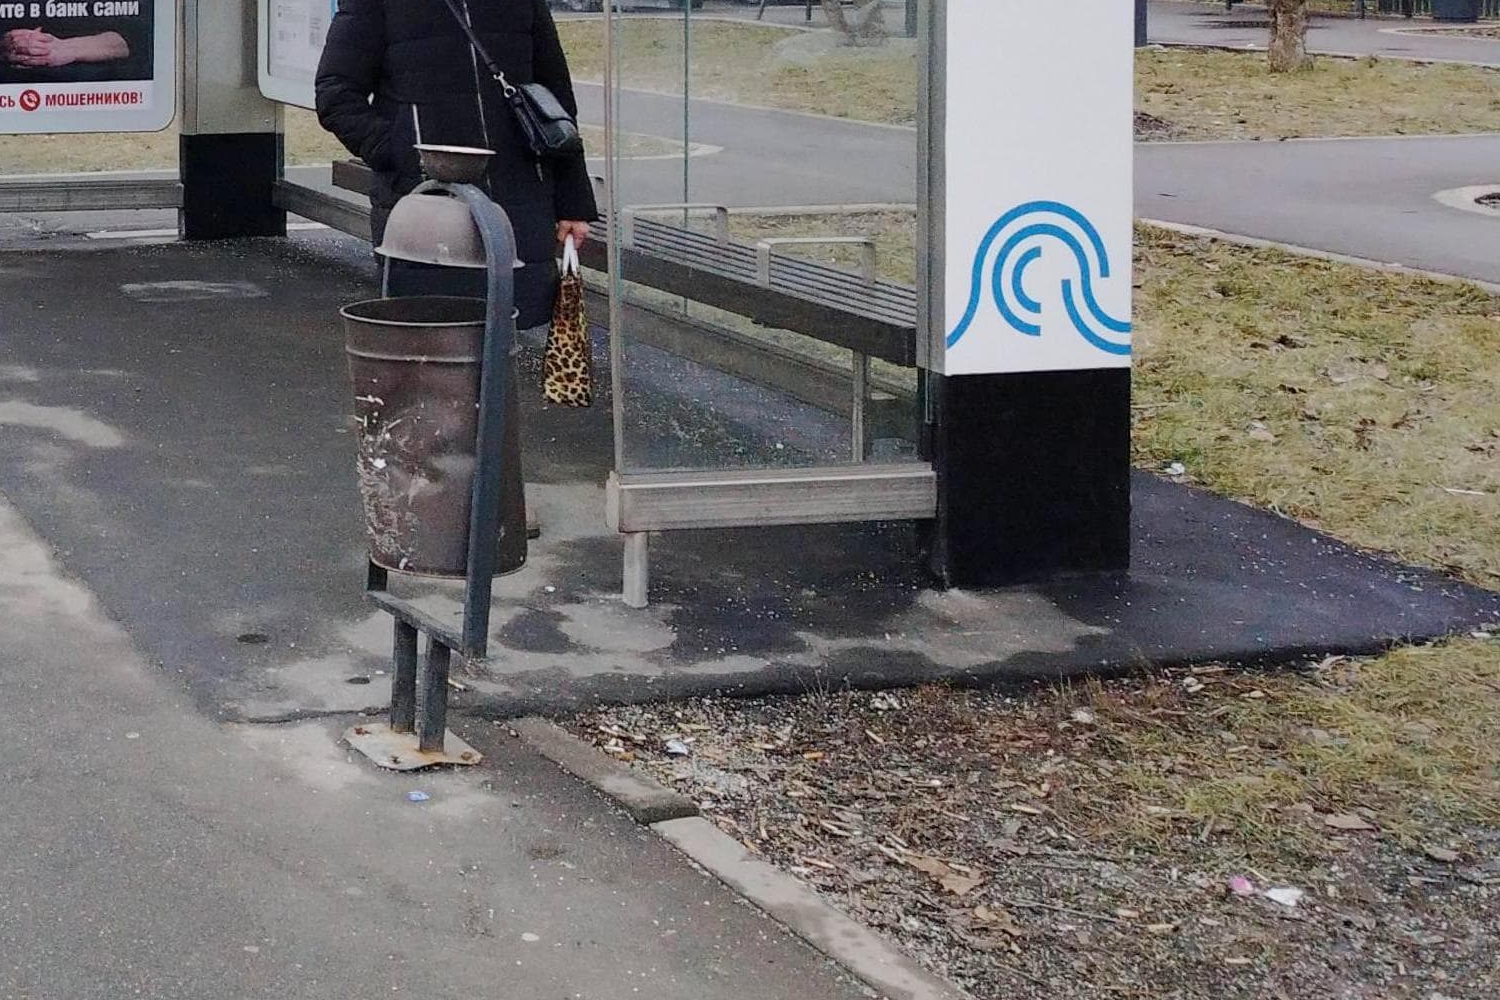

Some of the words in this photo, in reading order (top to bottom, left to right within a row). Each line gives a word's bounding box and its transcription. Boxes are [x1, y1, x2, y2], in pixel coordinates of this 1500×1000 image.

[30, 2, 41, 18] в
[45, 0, 89, 17] банк
[93, 0, 139, 16] сами
[45, 91, 143, 107] МОШЕННИКОВ!
